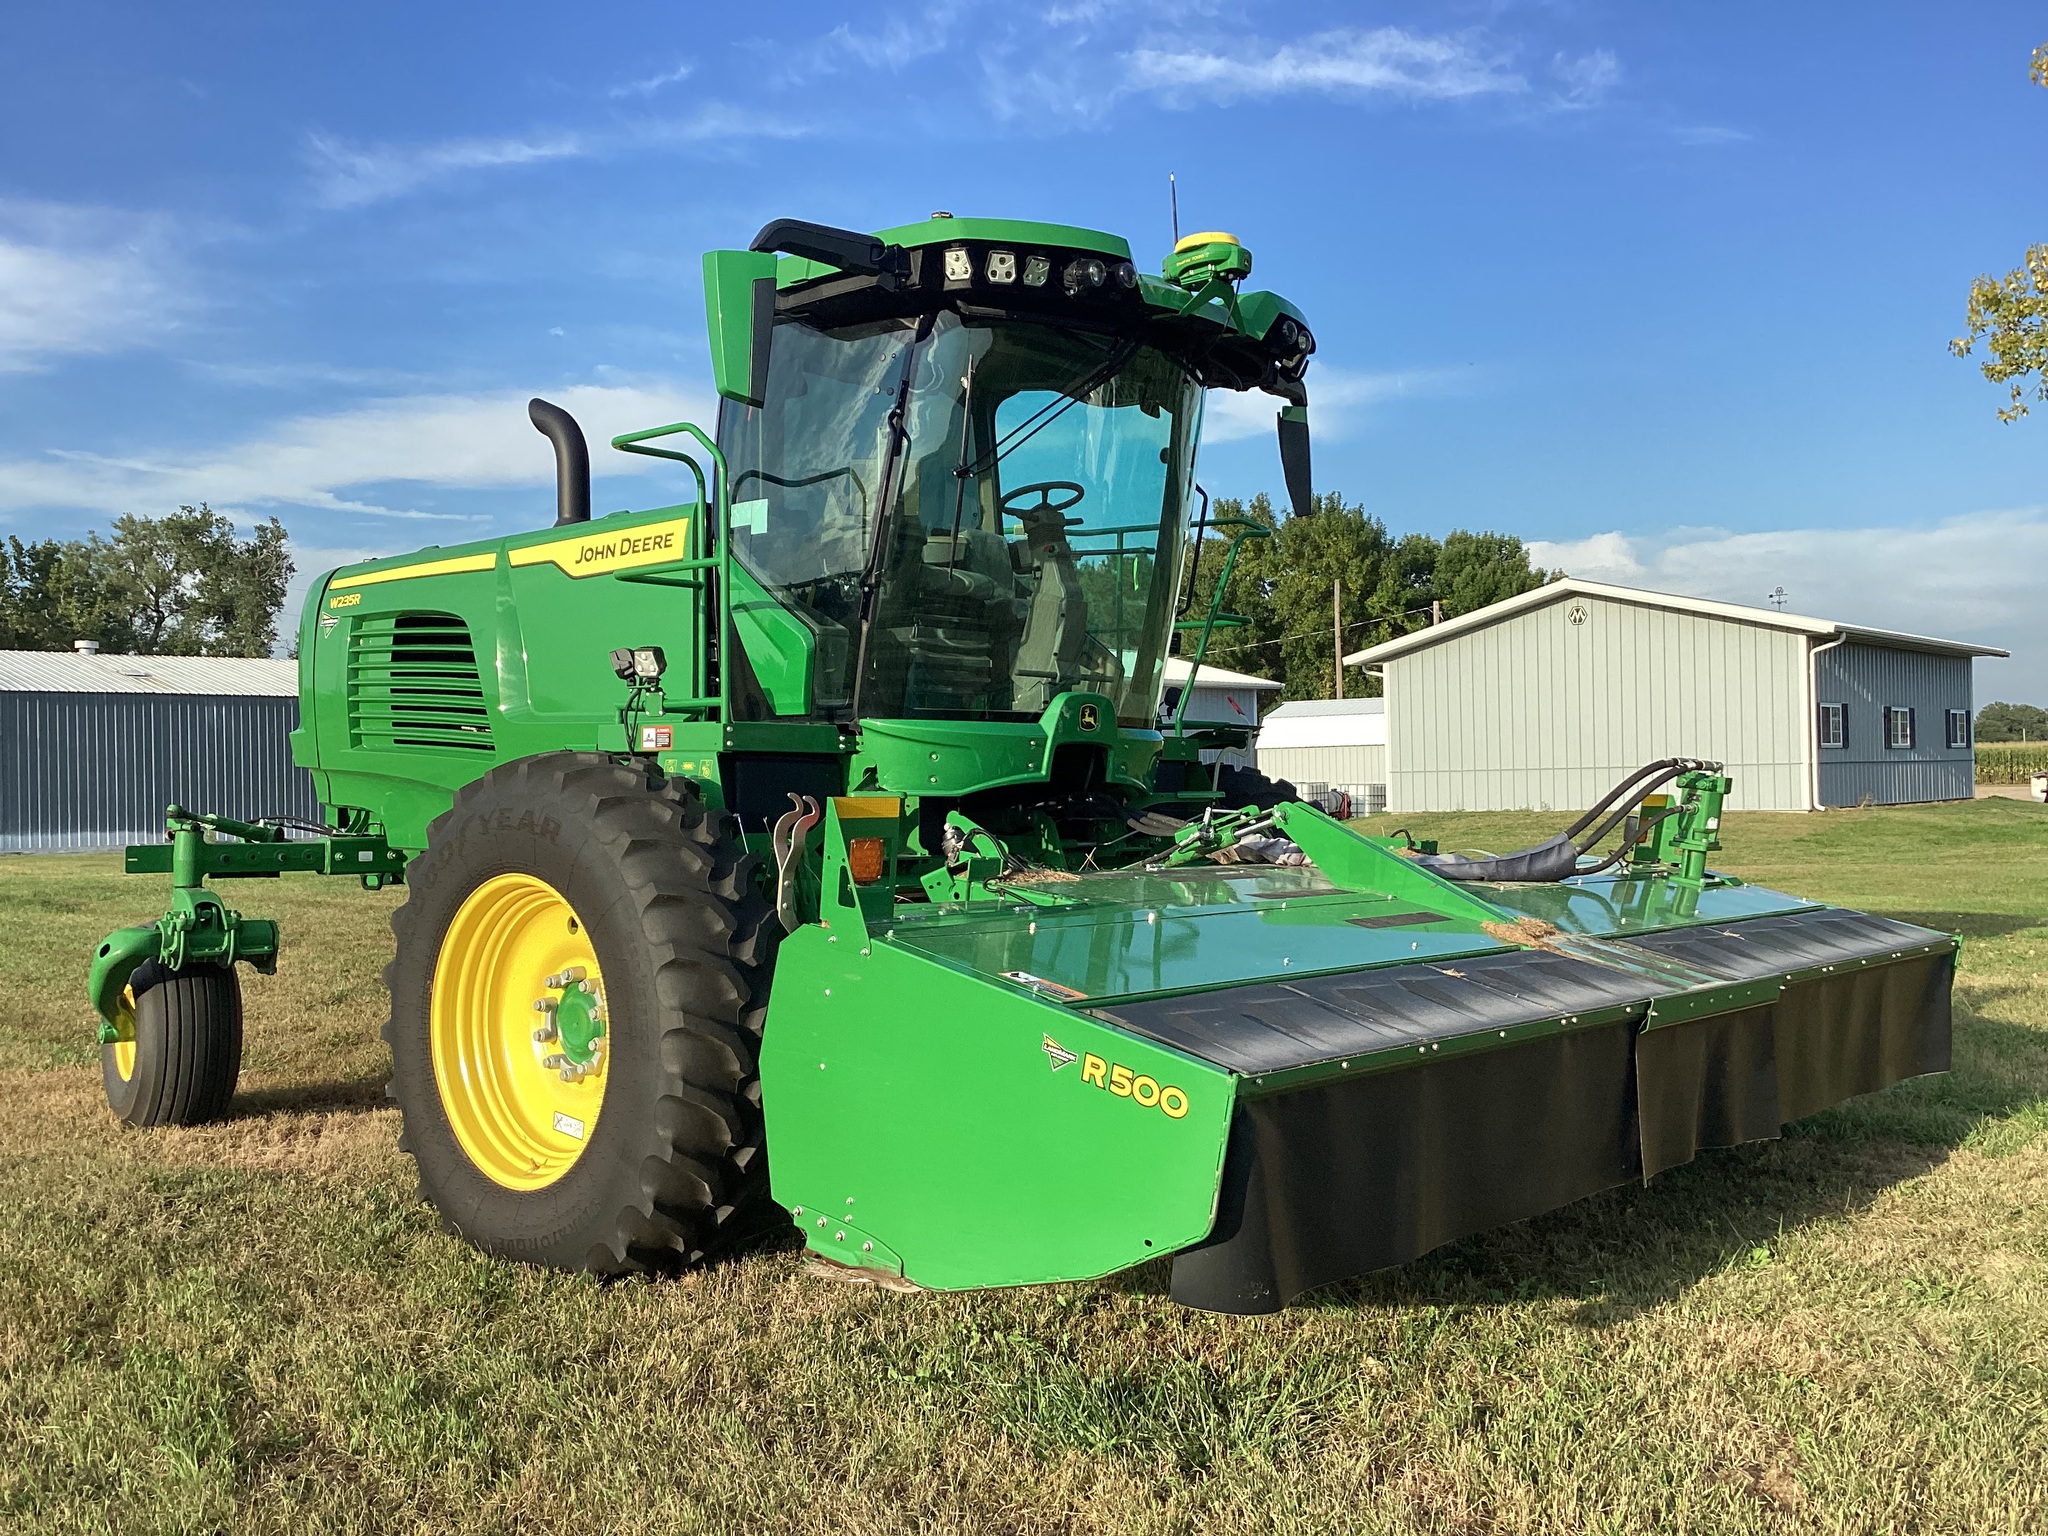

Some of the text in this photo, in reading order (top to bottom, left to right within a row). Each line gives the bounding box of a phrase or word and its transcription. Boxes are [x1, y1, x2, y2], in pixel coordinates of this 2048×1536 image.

[575, 532, 675, 565] JOHN DEERE
[329, 593, 362, 609] W235R
[1080, 1051, 1190, 1120] R500
